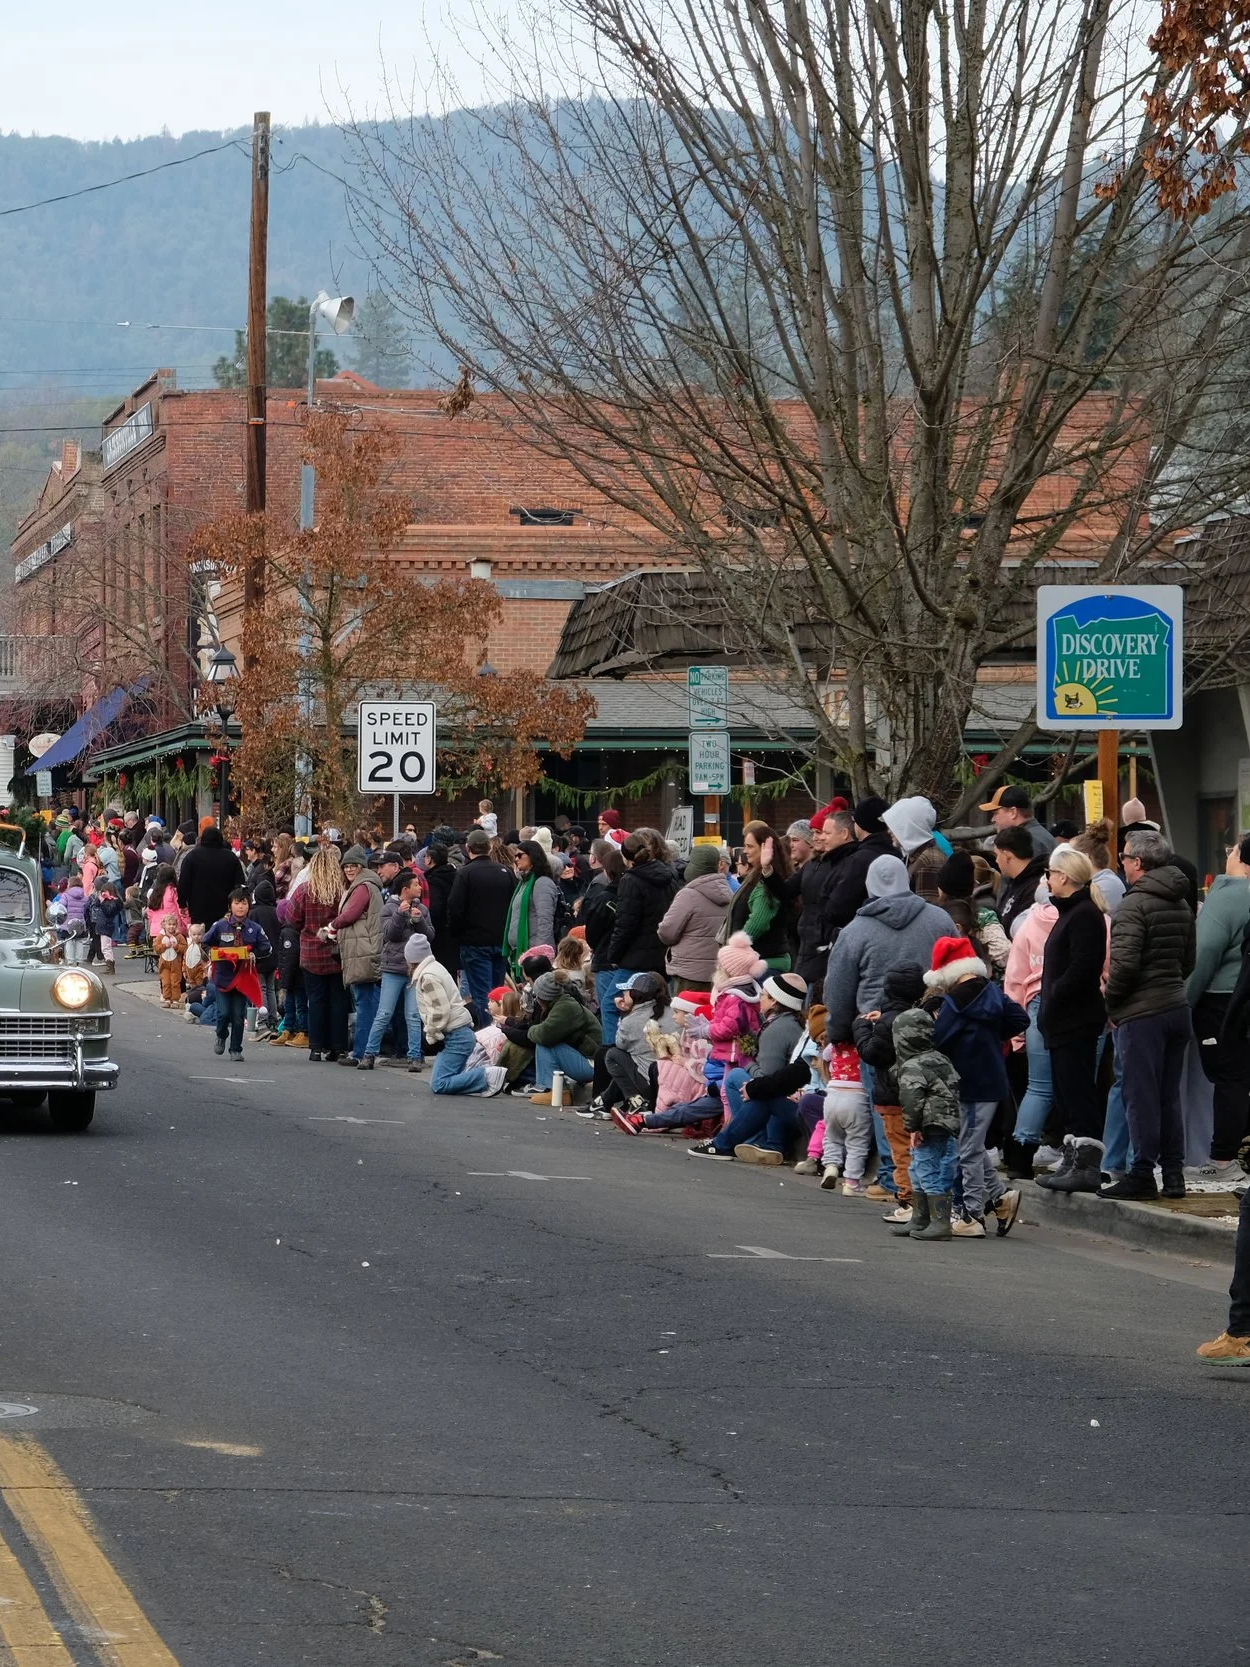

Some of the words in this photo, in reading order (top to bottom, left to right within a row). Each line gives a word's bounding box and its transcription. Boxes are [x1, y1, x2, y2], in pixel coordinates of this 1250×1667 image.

[1062, 633, 1159, 656] DISCOVERY
[1082, 658, 1141, 679] DRIVE
[690, 671, 700, 684] NO
[693, 688, 723, 696] VEHICLES
[701, 708, 716, 716] HIGH
[367, 712, 428, 726] SPEED
[373, 732, 421, 745] LIMIT
[702, 740, 717, 748] TWO
[699, 751, 720, 759] HOUR
[368, 751, 426, 783] 20
[695, 762, 725, 770] PARKING
[694, 773, 725, 782] 9AM-5PM
